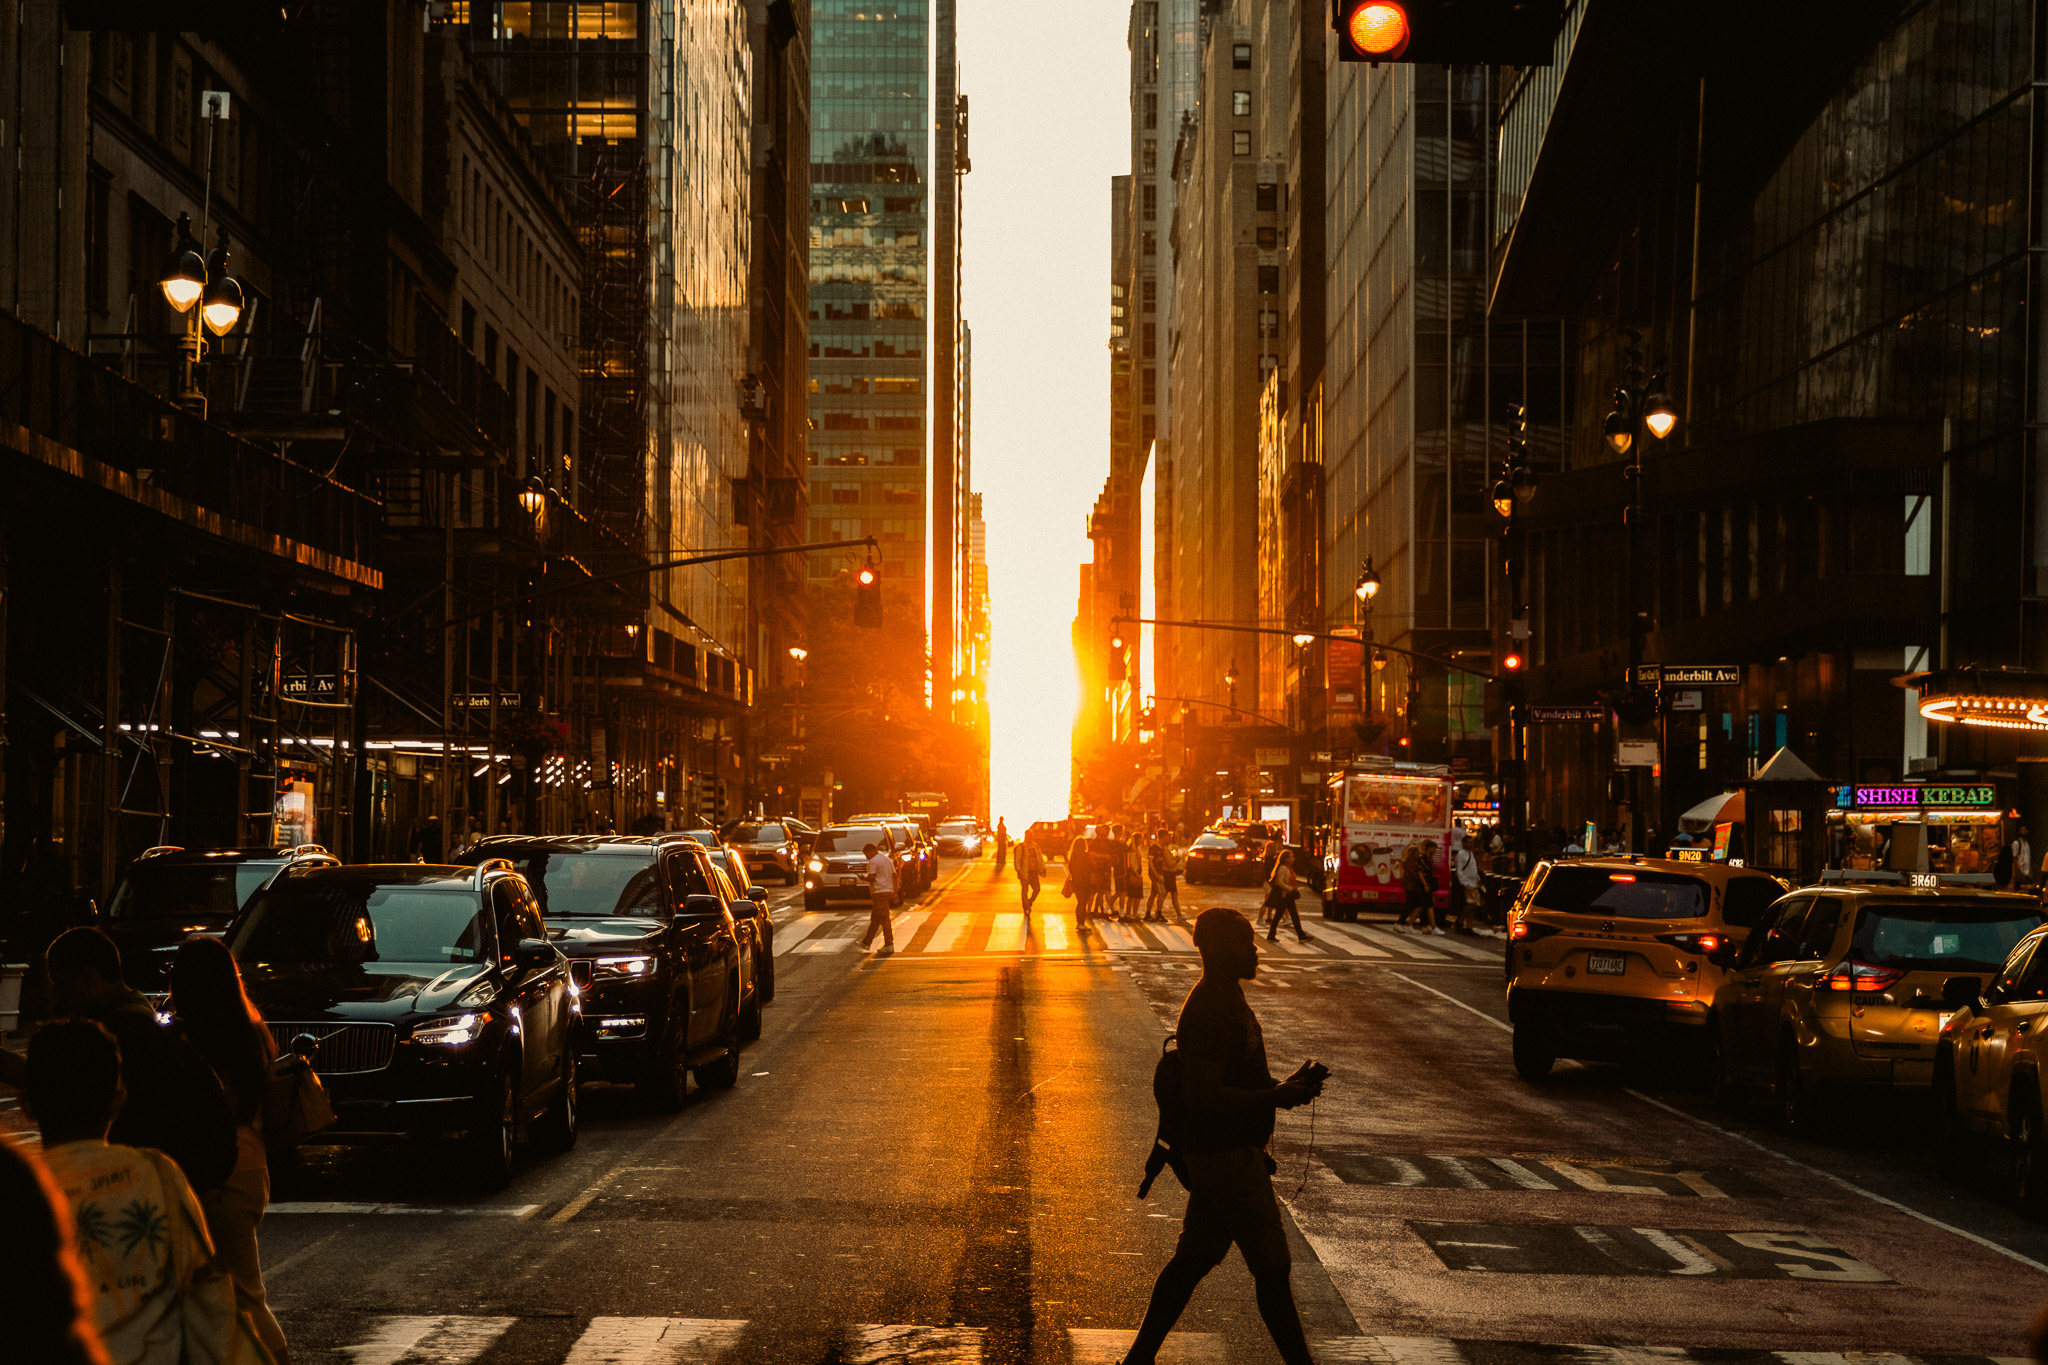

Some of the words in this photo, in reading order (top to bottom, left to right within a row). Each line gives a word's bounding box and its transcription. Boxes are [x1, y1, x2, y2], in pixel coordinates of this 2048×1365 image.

[1664, 670, 1713, 681] anderbilt
[1716, 670, 1737, 681] Ave
[318, 680, 335, 691] Av
[1534, 709, 1581, 719] Vanderbilt
[1585, 710, 1603, 719] Ave
[1857, 788, 1919, 805] SHISH
[1922, 788, 1994, 805] KEBAB
[1679, 851, 1702, 861] 9N20
[1911, 875, 1937, 887] 3R60
